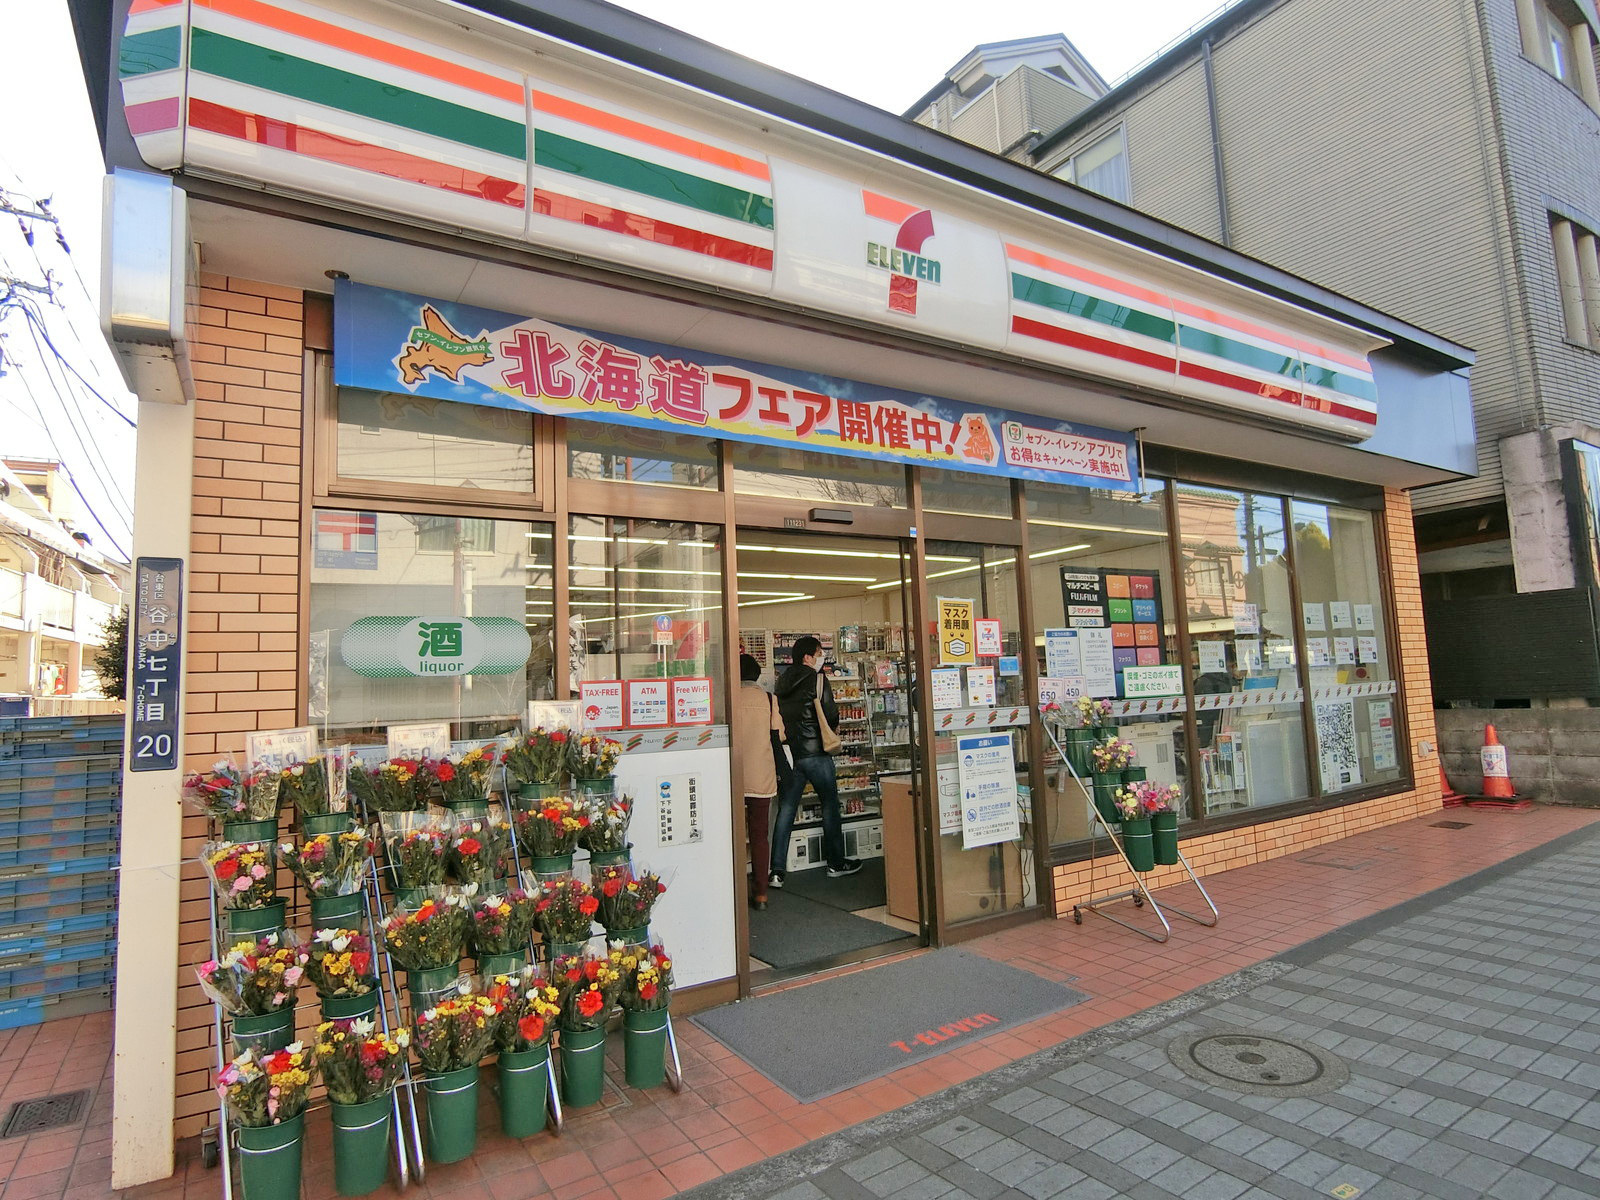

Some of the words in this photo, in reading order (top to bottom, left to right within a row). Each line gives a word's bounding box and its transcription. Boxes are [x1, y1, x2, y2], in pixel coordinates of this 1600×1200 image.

[1026, 433, 1123, 460] セブン-イレブンアプリで
[1010, 445, 1126, 477] お得なキャンペーン実施中!
[154, 573, 166, 600] 台東区
[1070, 592, 1098, 602] FUJIFILM
[943, 608, 968, 618] マスク
[418, 621, 463, 657] 酒
[137, 636, 147, 670] YANAKA
[145, 606, 169, 722] 谷中七丁目
[419, 661, 464, 674] liquor
[640, 687, 657, 695] ATM
[676, 686, 690, 694] Free
[1040, 690, 1056, 700] 650
[1066, 687, 1080, 697] 450
[136, 684, 146, 722] 7-CHOME
[137, 734, 172, 758] 20
